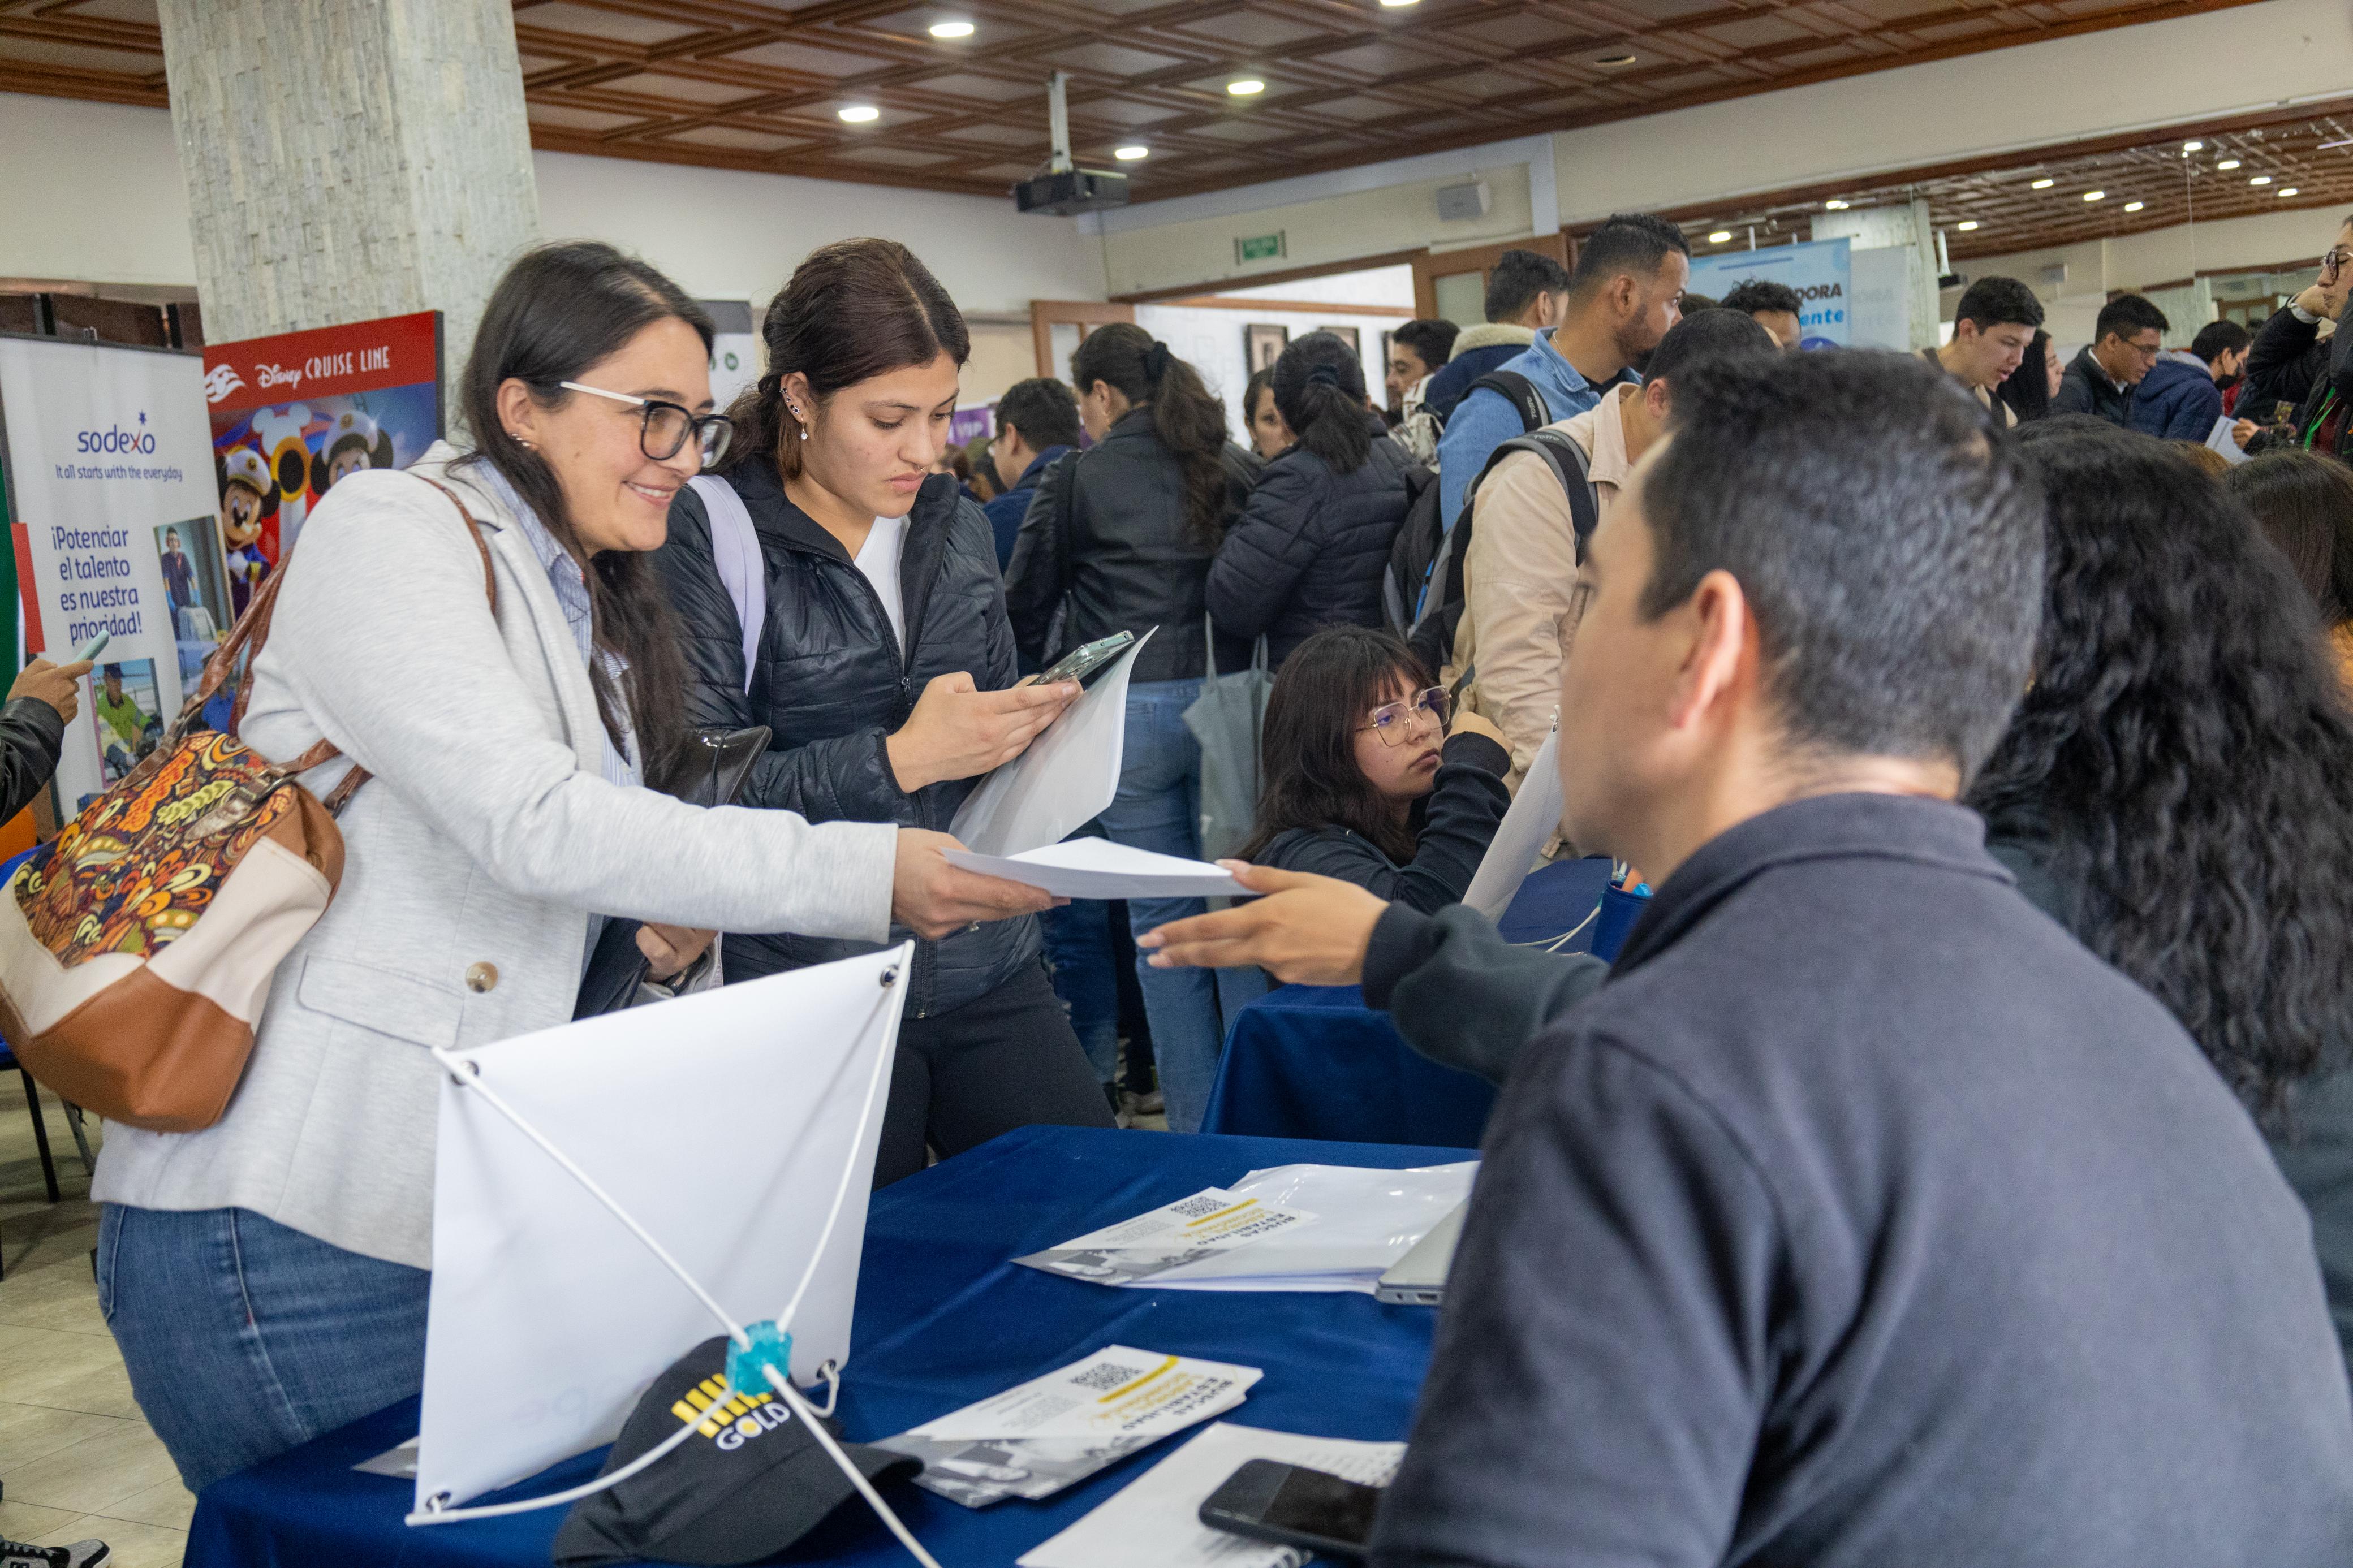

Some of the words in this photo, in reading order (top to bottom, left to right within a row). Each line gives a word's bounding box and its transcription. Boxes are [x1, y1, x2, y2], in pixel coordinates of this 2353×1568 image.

[1794, 283, 1843, 301] DORA
[1799, 309, 1845, 327] ente
[255, 364, 303, 389] Disney
[305, 351, 354, 379] CRUISE
[360, 345, 390, 372] LINE
[77, 424, 156, 454] sodexo
[55, 464, 63, 479] It
[64, 464, 76, 479] all
[77, 465, 103, 479] starts
[104, 465, 127, 479] with
[128, 465, 141, 479] the
[143, 466, 183, 482] everyday
[51, 524, 128, 550] ¡Potenciar
[59, 556, 73, 580] el
[75, 555, 131, 580] talento
[61, 593, 77, 611] es
[80, 586, 140, 610] nuestra
[69, 611, 143, 646] prioridad!
[716, 1402, 791, 1451] GOLD
